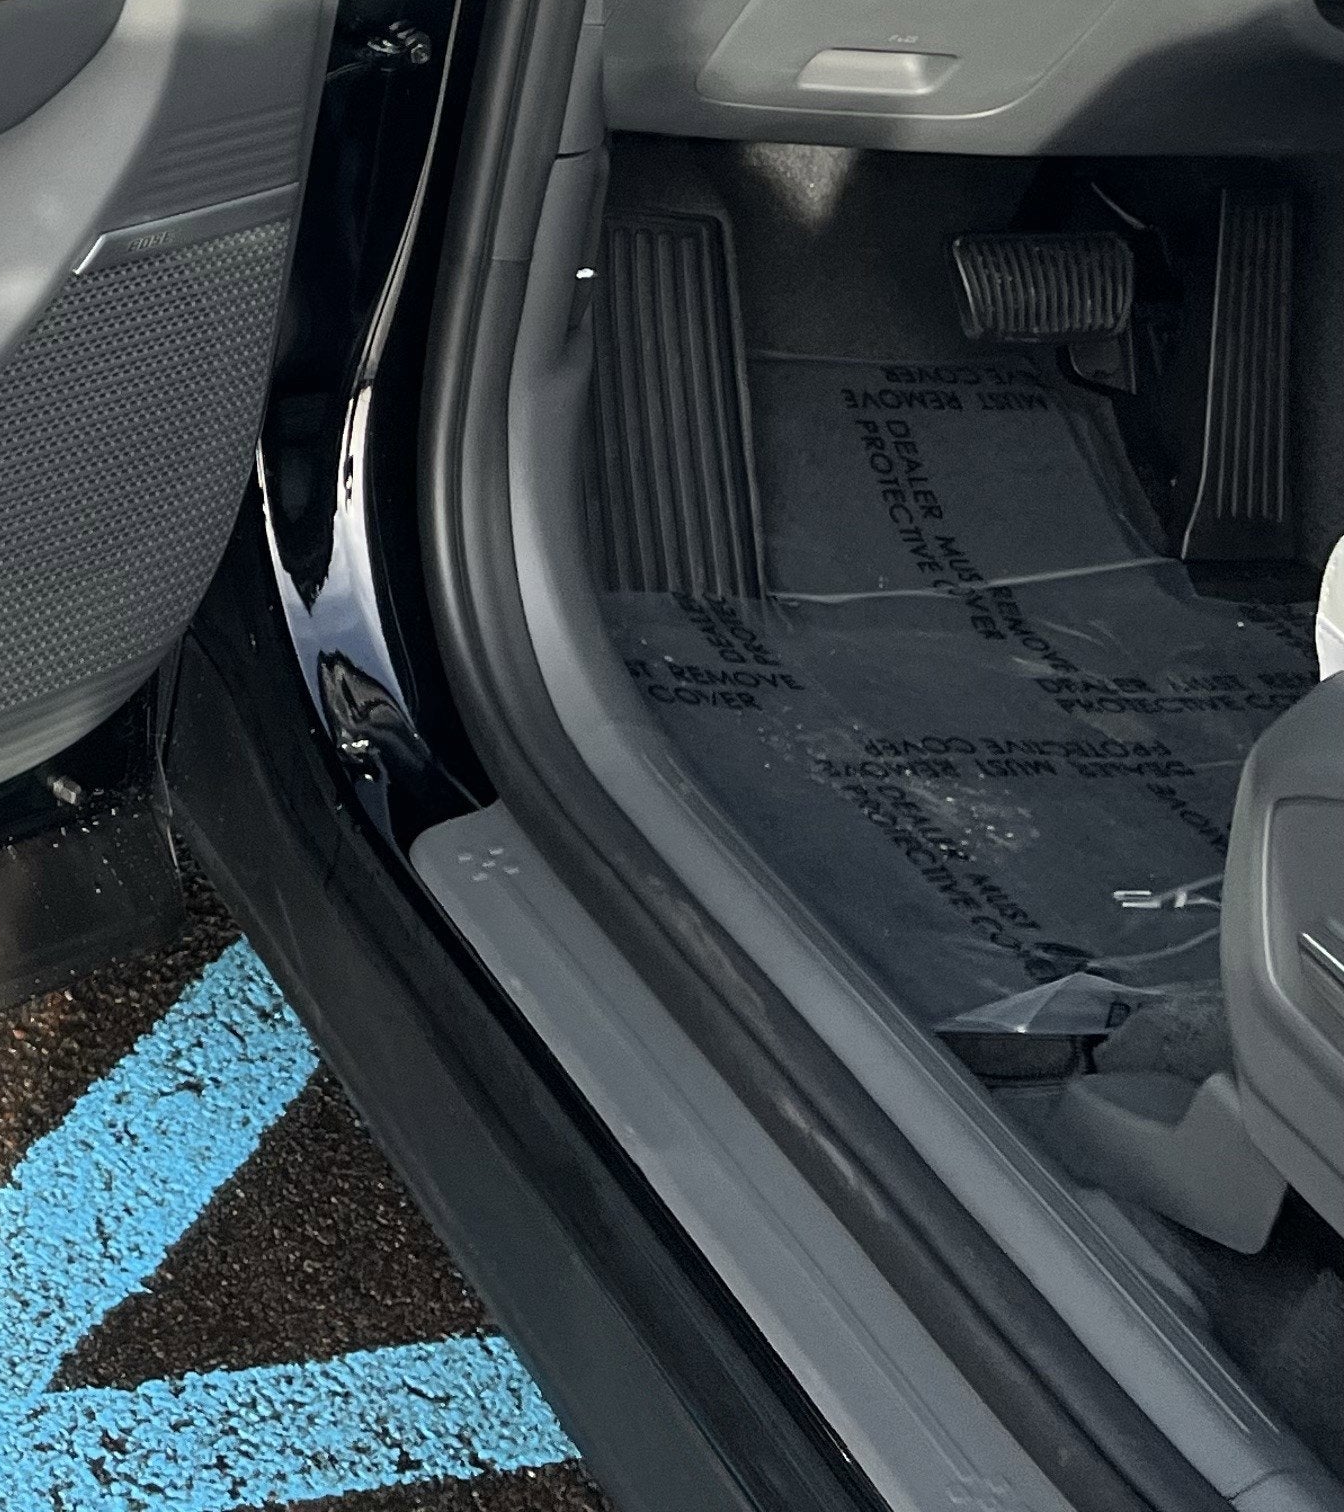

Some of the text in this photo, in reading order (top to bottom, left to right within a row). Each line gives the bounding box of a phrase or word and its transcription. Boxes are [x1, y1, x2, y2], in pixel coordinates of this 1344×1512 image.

[841, 388, 963, 411] REMOVE
[885, 419, 944, 521] DEALER
[855, 418, 944, 574] PROTECTIVE
[666, 661, 805, 691] REMOVE
[647, 684, 764, 712] COVER
